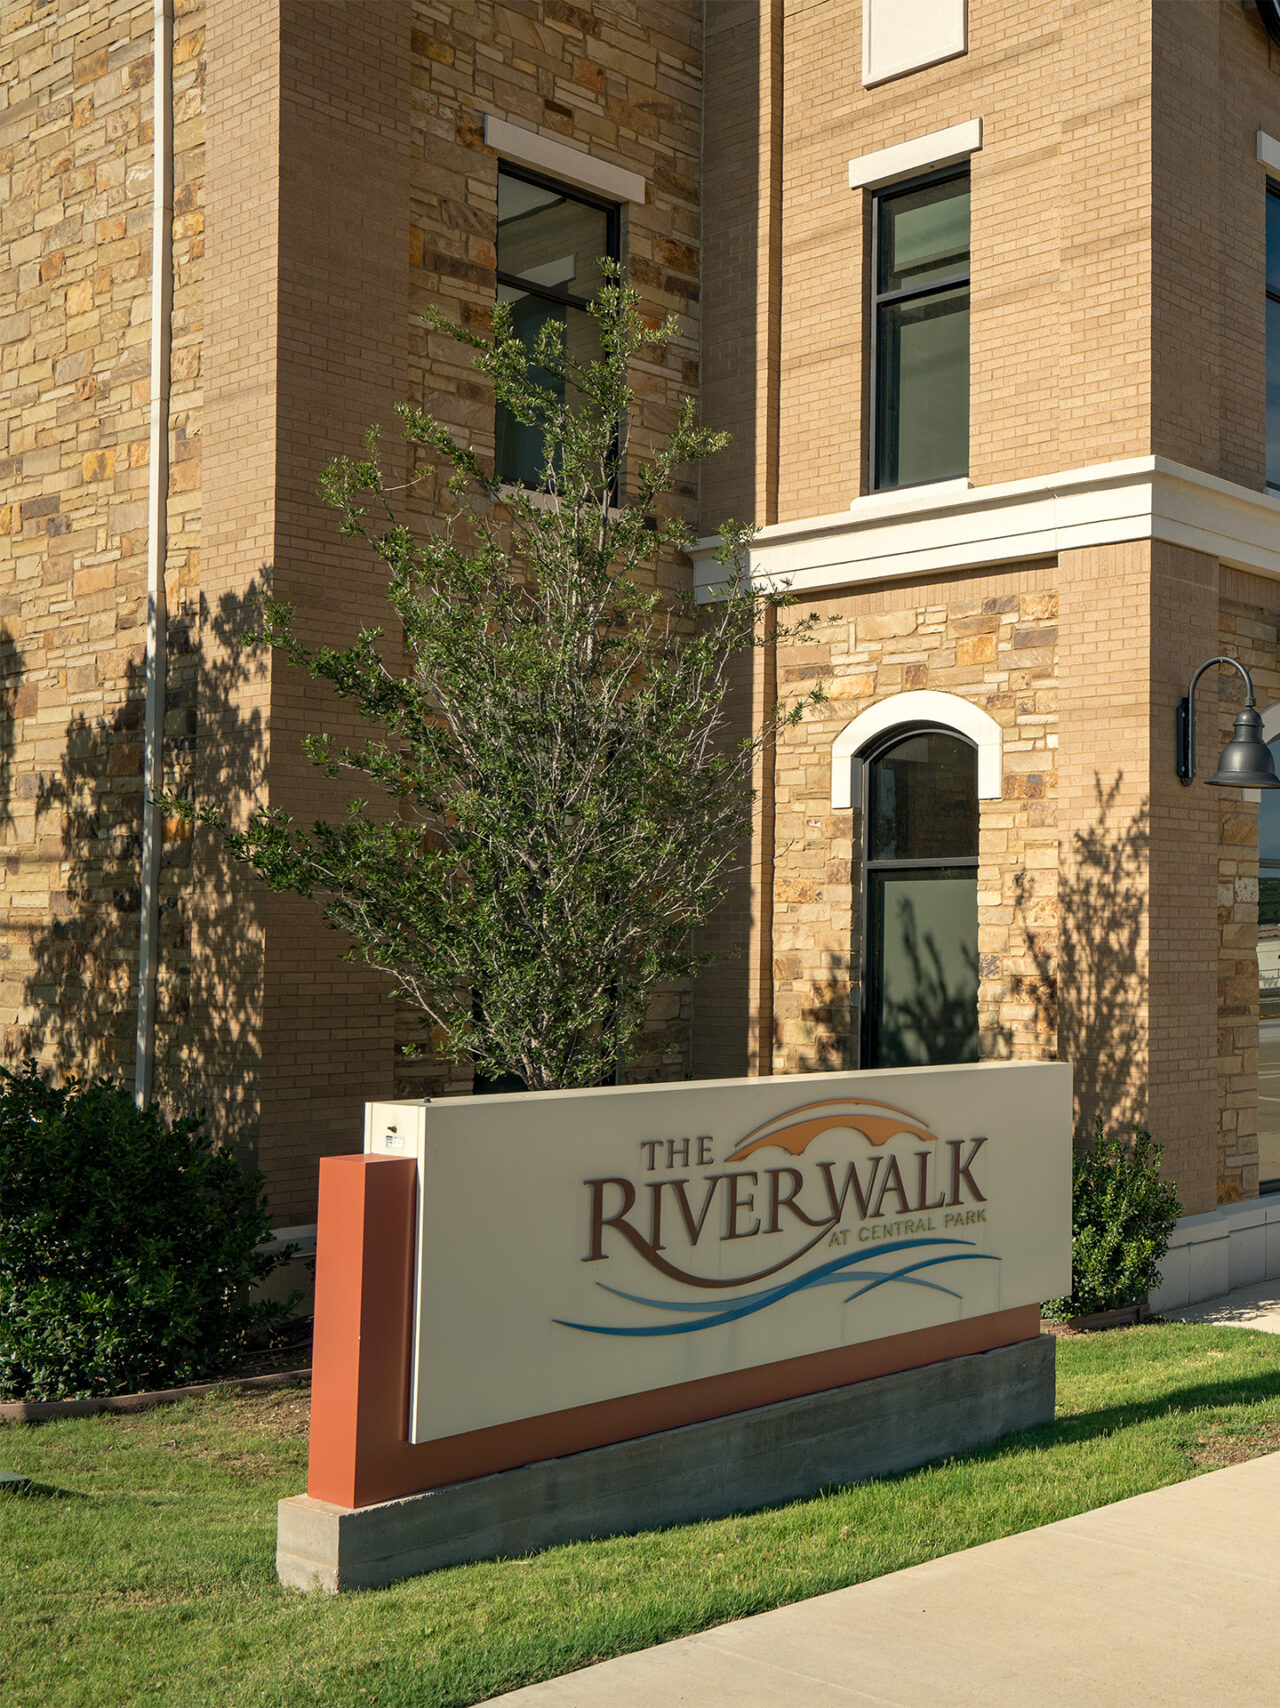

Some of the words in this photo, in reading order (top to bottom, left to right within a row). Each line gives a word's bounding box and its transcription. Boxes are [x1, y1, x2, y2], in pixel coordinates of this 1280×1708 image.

[641, 1136, 714, 1171] THE
[581, 1137, 988, 1289] RIVERWALK
[828, 1229, 850, 1247] AT
[858, 1217, 937, 1242] CENTRAL
[945, 1209, 987, 1228] PARK
